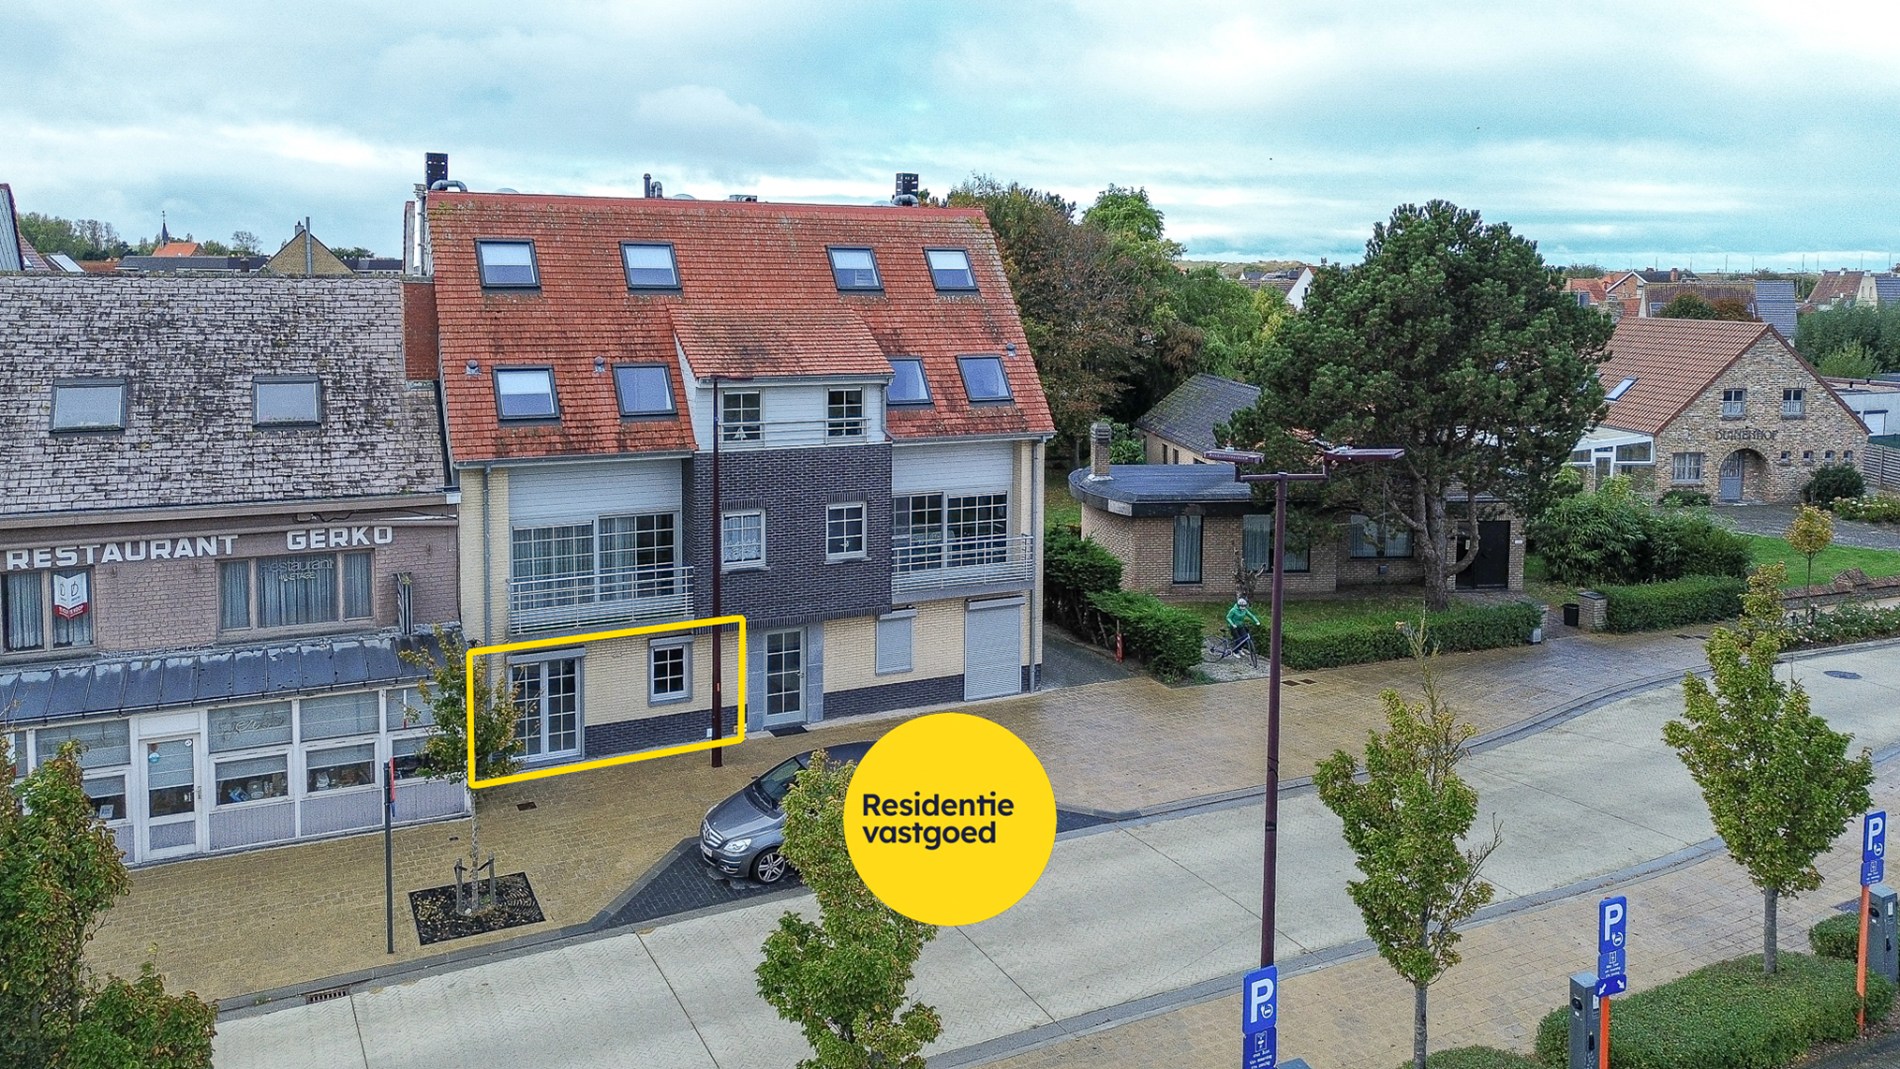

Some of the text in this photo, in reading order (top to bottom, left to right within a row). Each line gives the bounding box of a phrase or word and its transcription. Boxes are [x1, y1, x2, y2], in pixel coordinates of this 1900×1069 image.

[6, 526, 393, 570] RESTAURANT GERKO
[1867, 816, 1883, 851] P
[1604, 903, 1623, 942] P
[1250, 978, 1274, 1024] P
